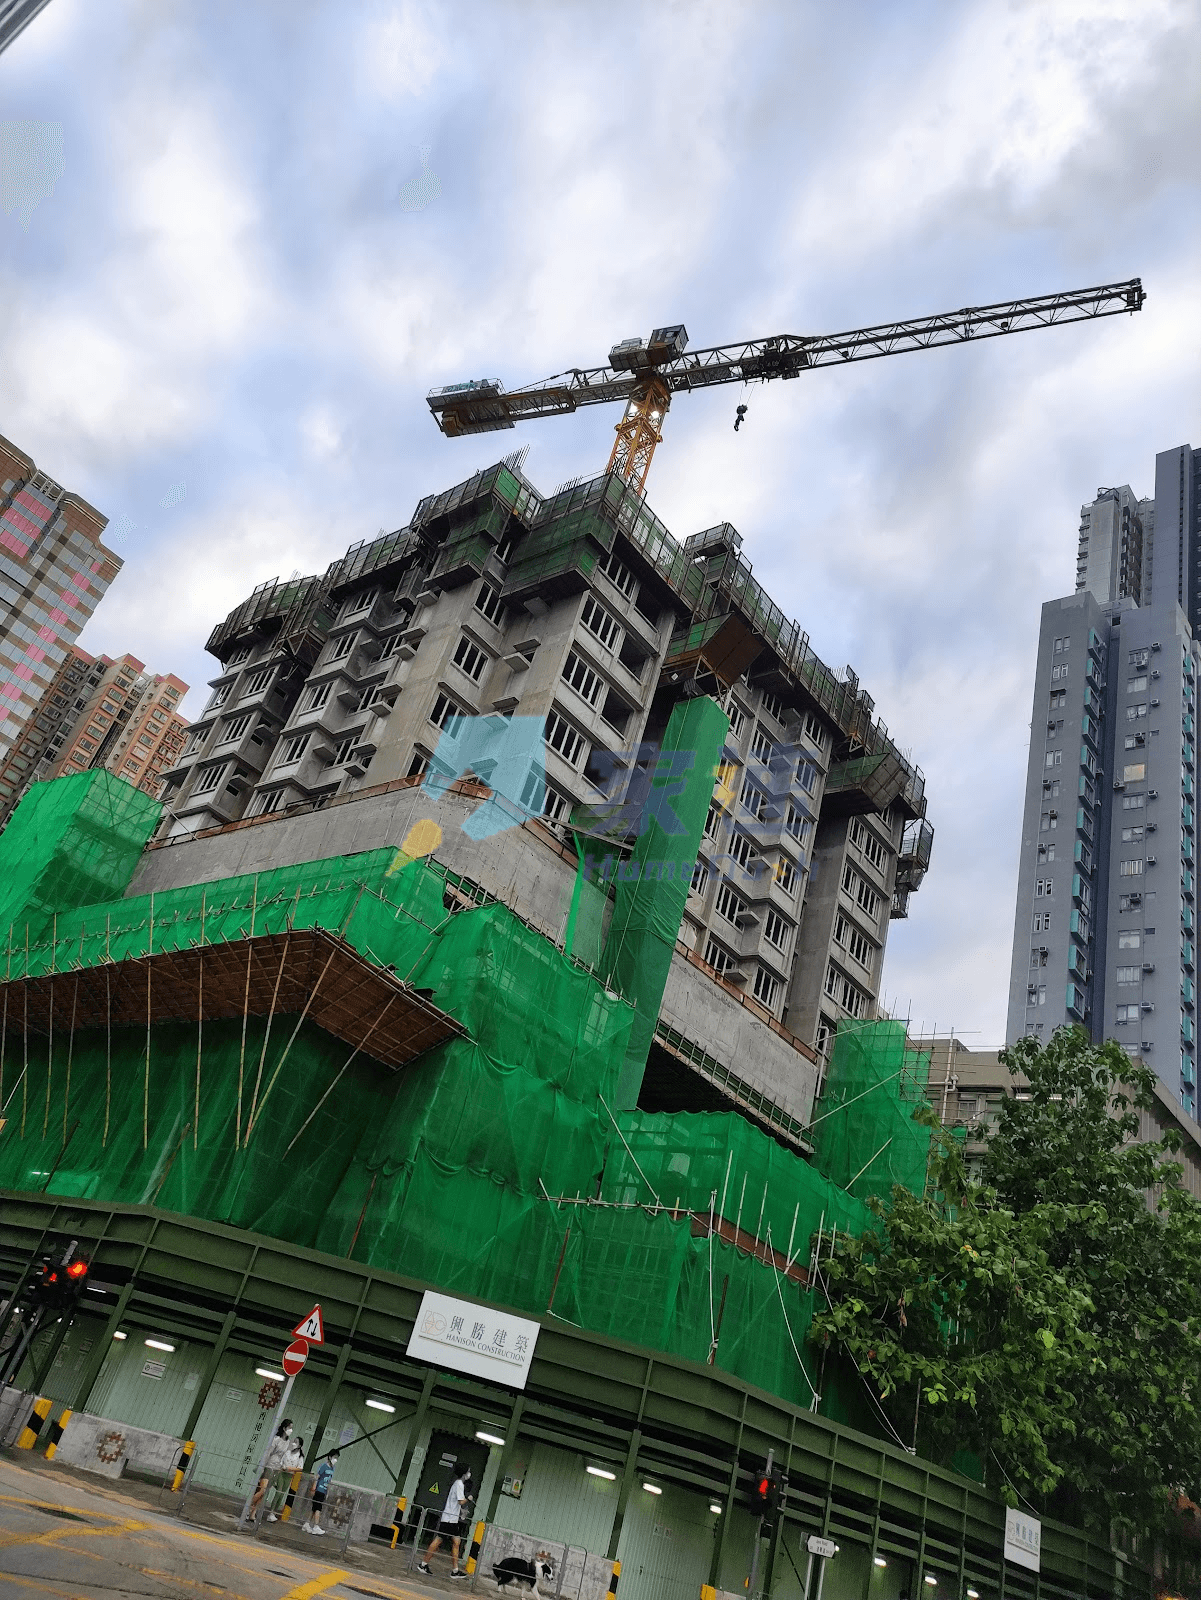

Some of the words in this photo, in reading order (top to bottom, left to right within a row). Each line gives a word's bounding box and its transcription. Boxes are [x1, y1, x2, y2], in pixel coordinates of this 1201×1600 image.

[446, 1333, 477, 1348] HANISON
[477, 1342, 526, 1363] CONSTRUCTION
[449, 1315, 530, 1354] 興勝建築
